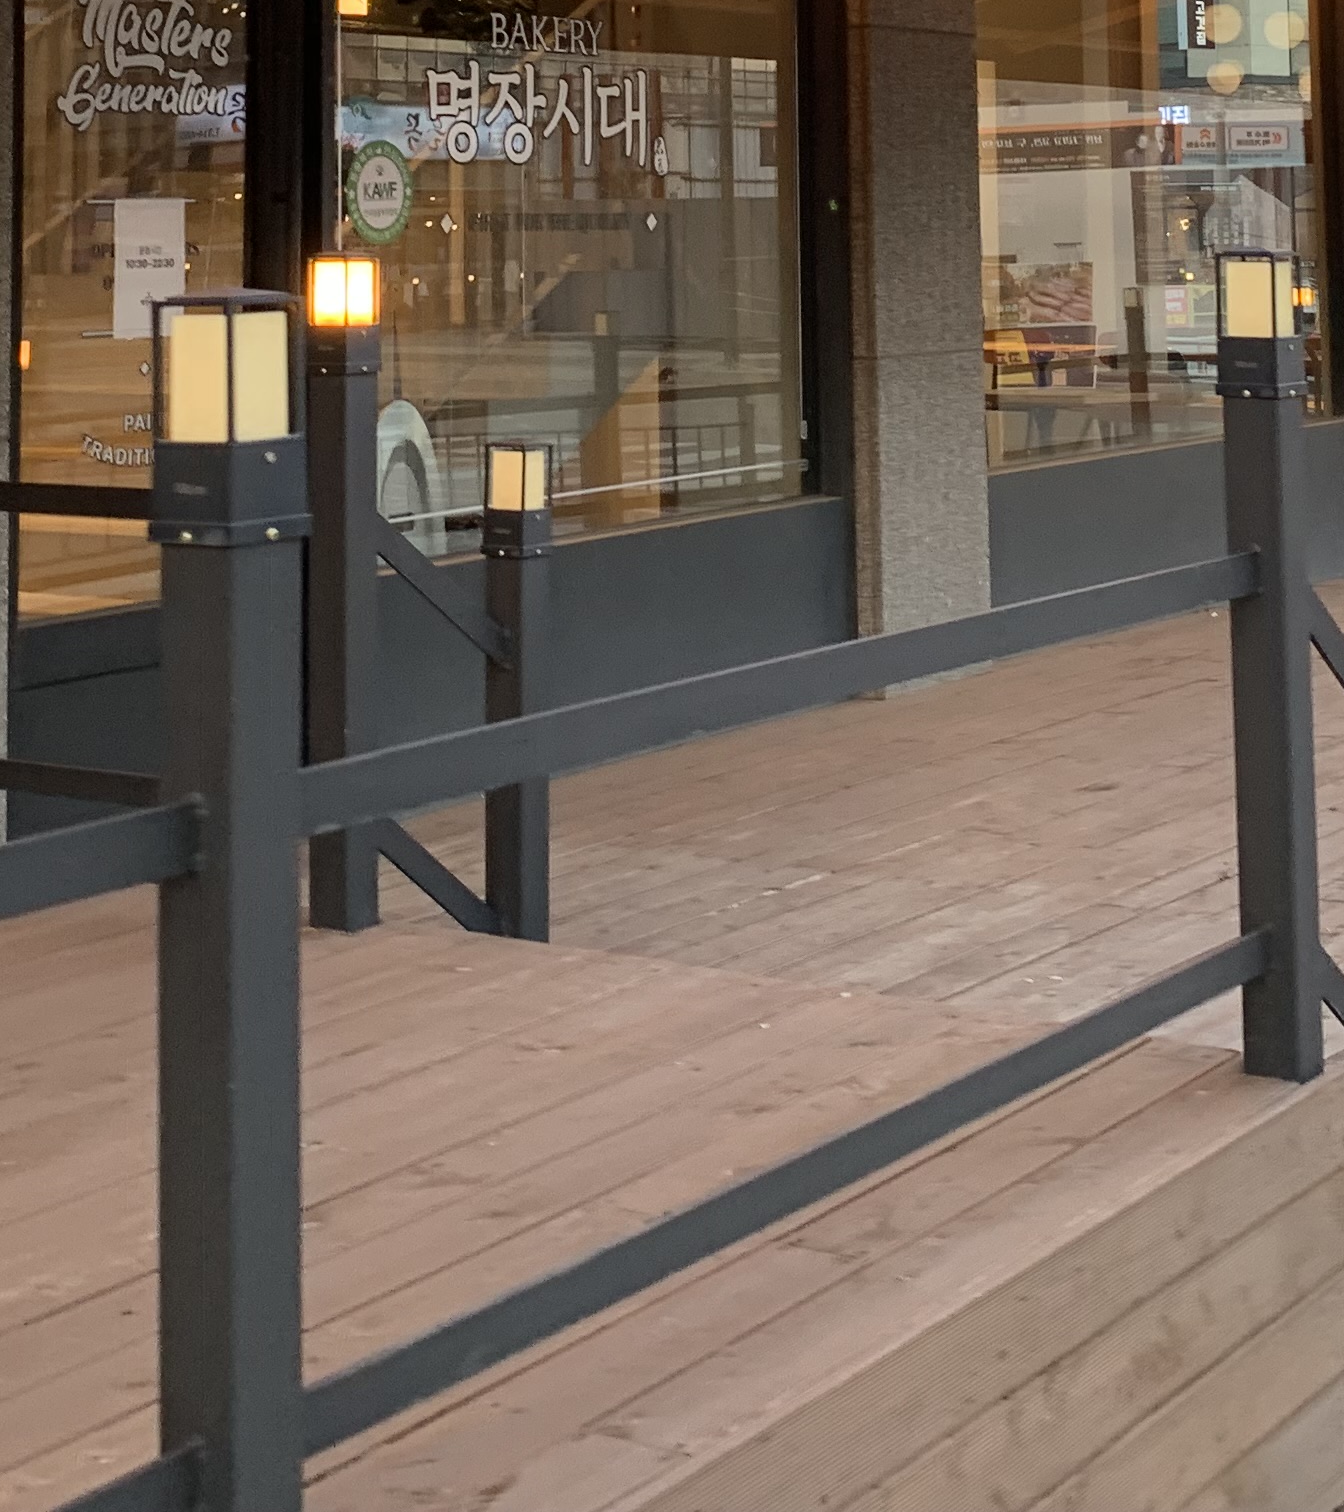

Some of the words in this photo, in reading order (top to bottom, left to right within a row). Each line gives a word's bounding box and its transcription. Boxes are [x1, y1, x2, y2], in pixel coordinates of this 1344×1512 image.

[489, 11, 604, 57] BAKERY
[57, 63, 229, 133] Generation
[426, 59, 648, 167] 명장시대
